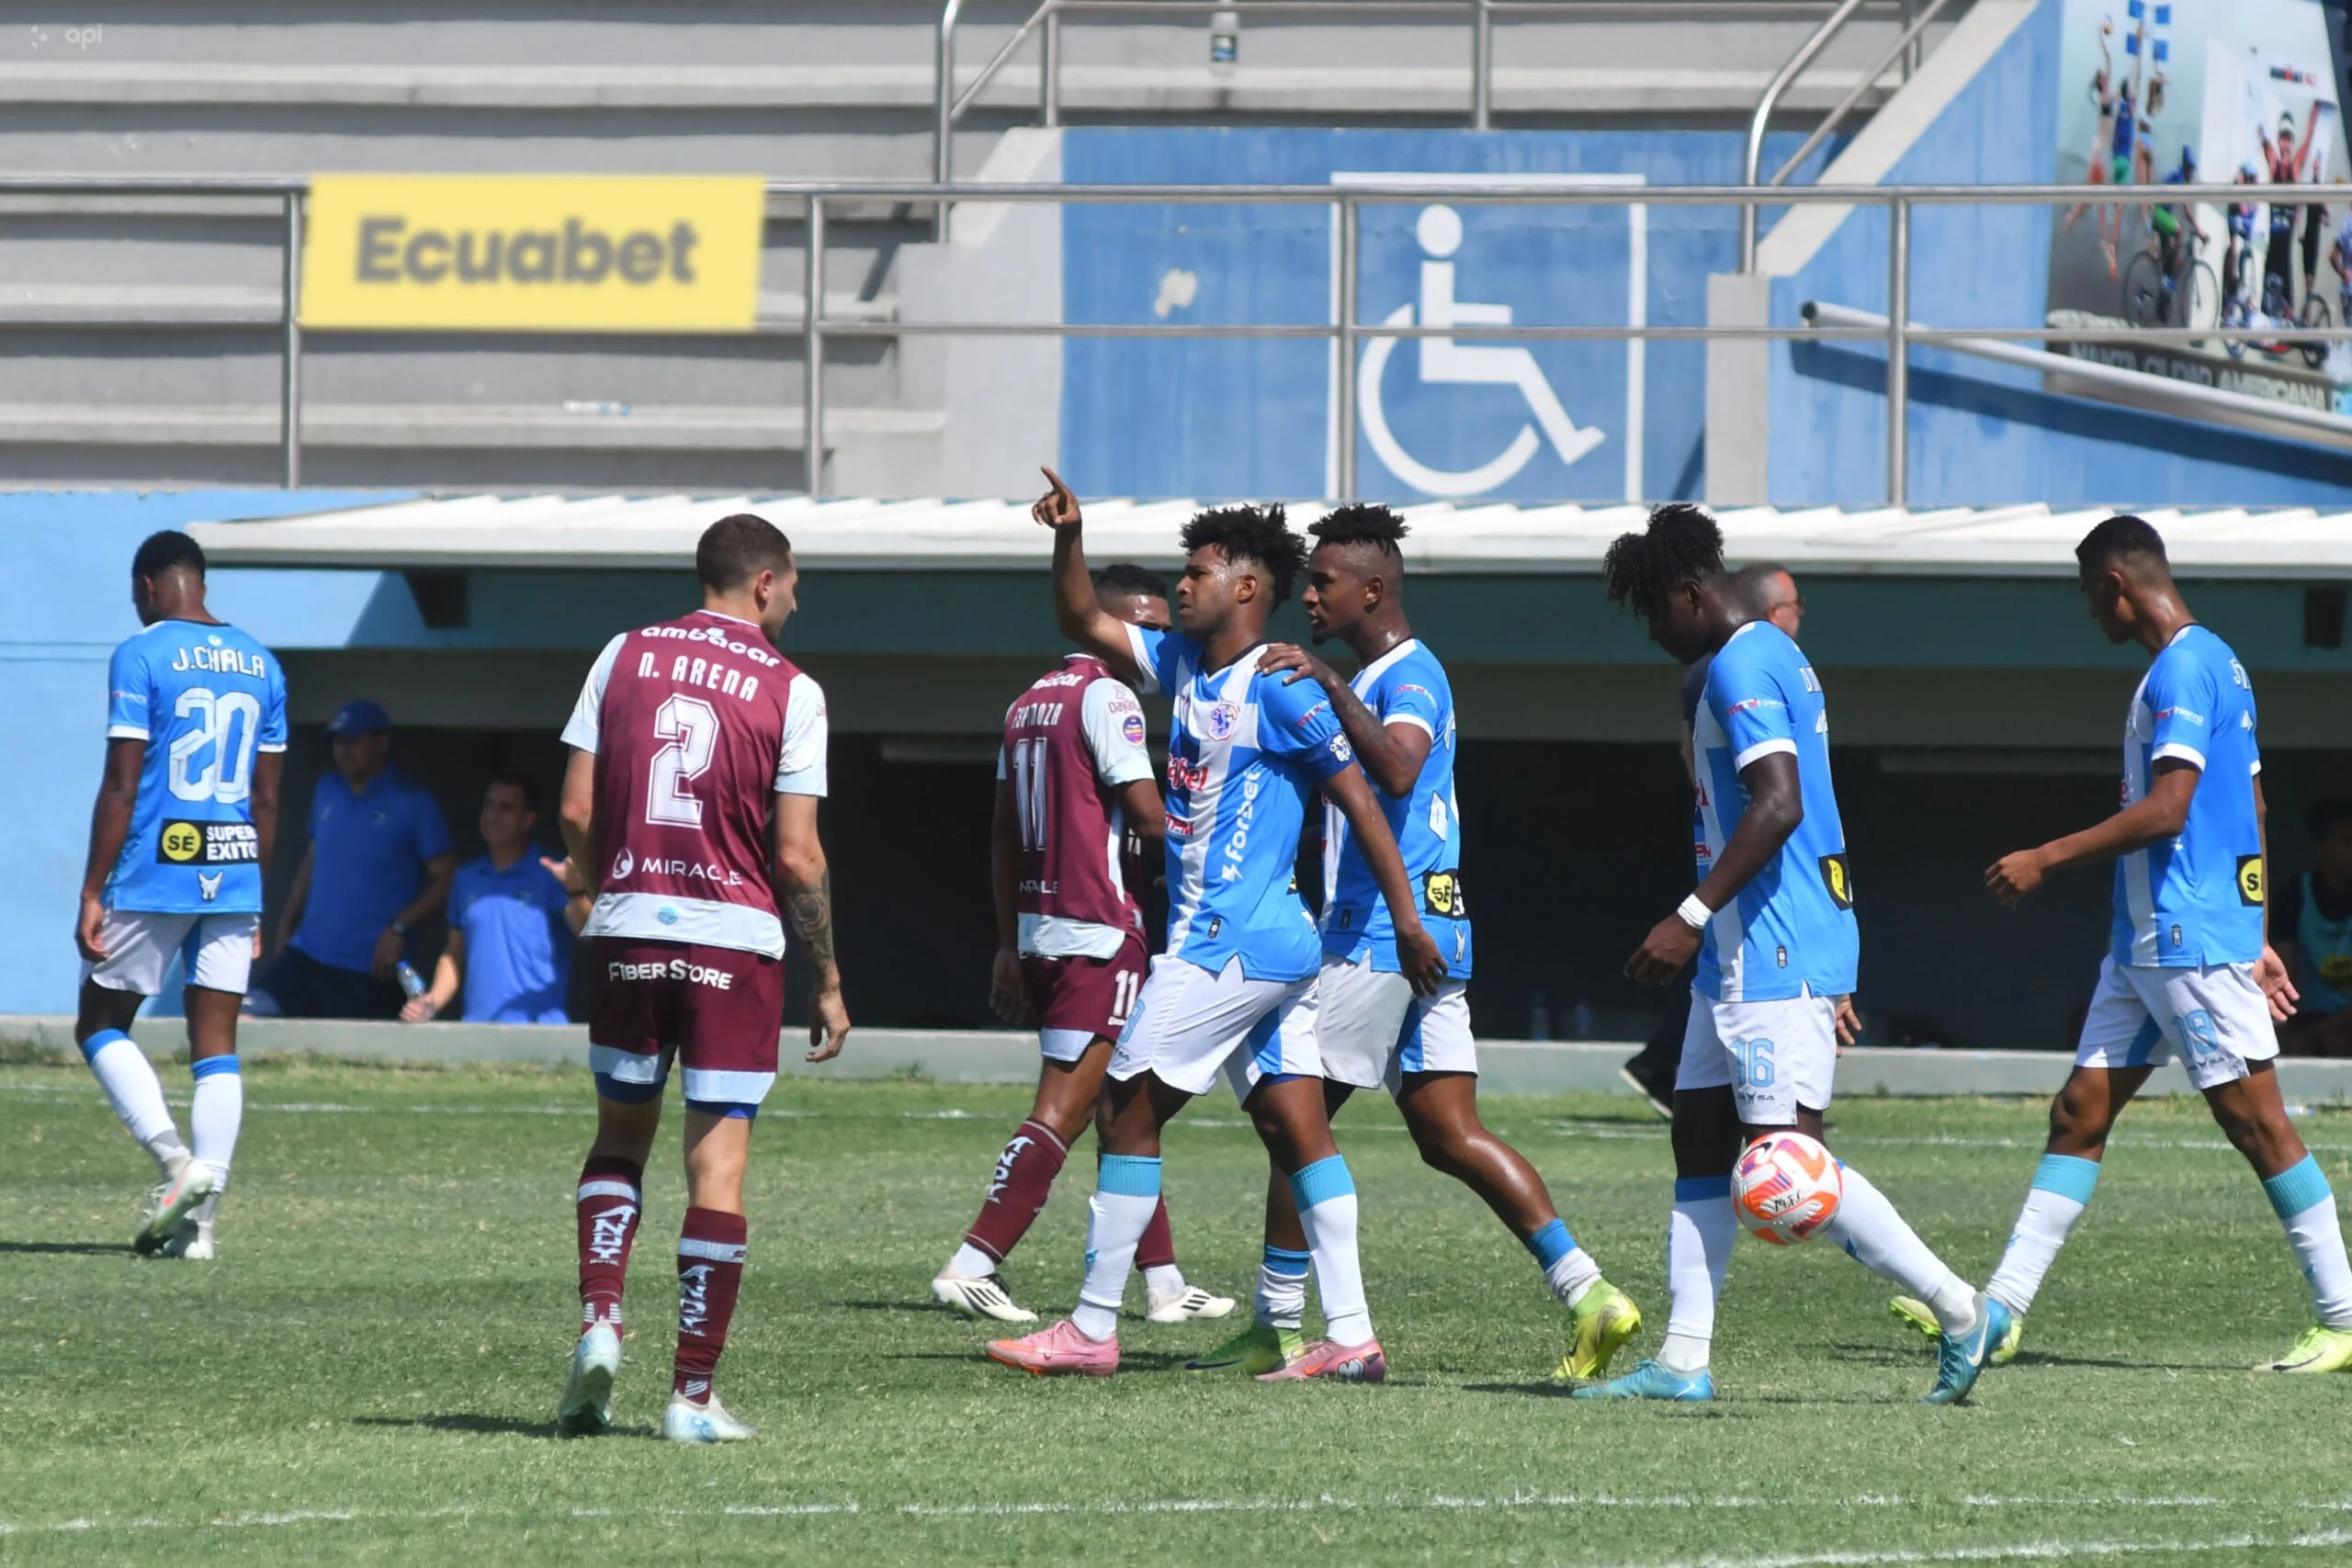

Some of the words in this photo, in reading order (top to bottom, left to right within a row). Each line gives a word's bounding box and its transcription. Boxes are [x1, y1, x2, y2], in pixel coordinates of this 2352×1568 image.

[355, 214, 700, 286] Ecuabet
[172, 646, 266, 680] J.CHALA
[640, 626, 780, 668] ambacar
[671, 655, 760, 703] ARENA
[168, 687, 261, 805] 20
[644, 692, 719, 830] 2
[1013, 737, 1047, 852] 11
[1107, 969, 1139, 1026] 11
[1729, 1037, 1775, 1088] 16
